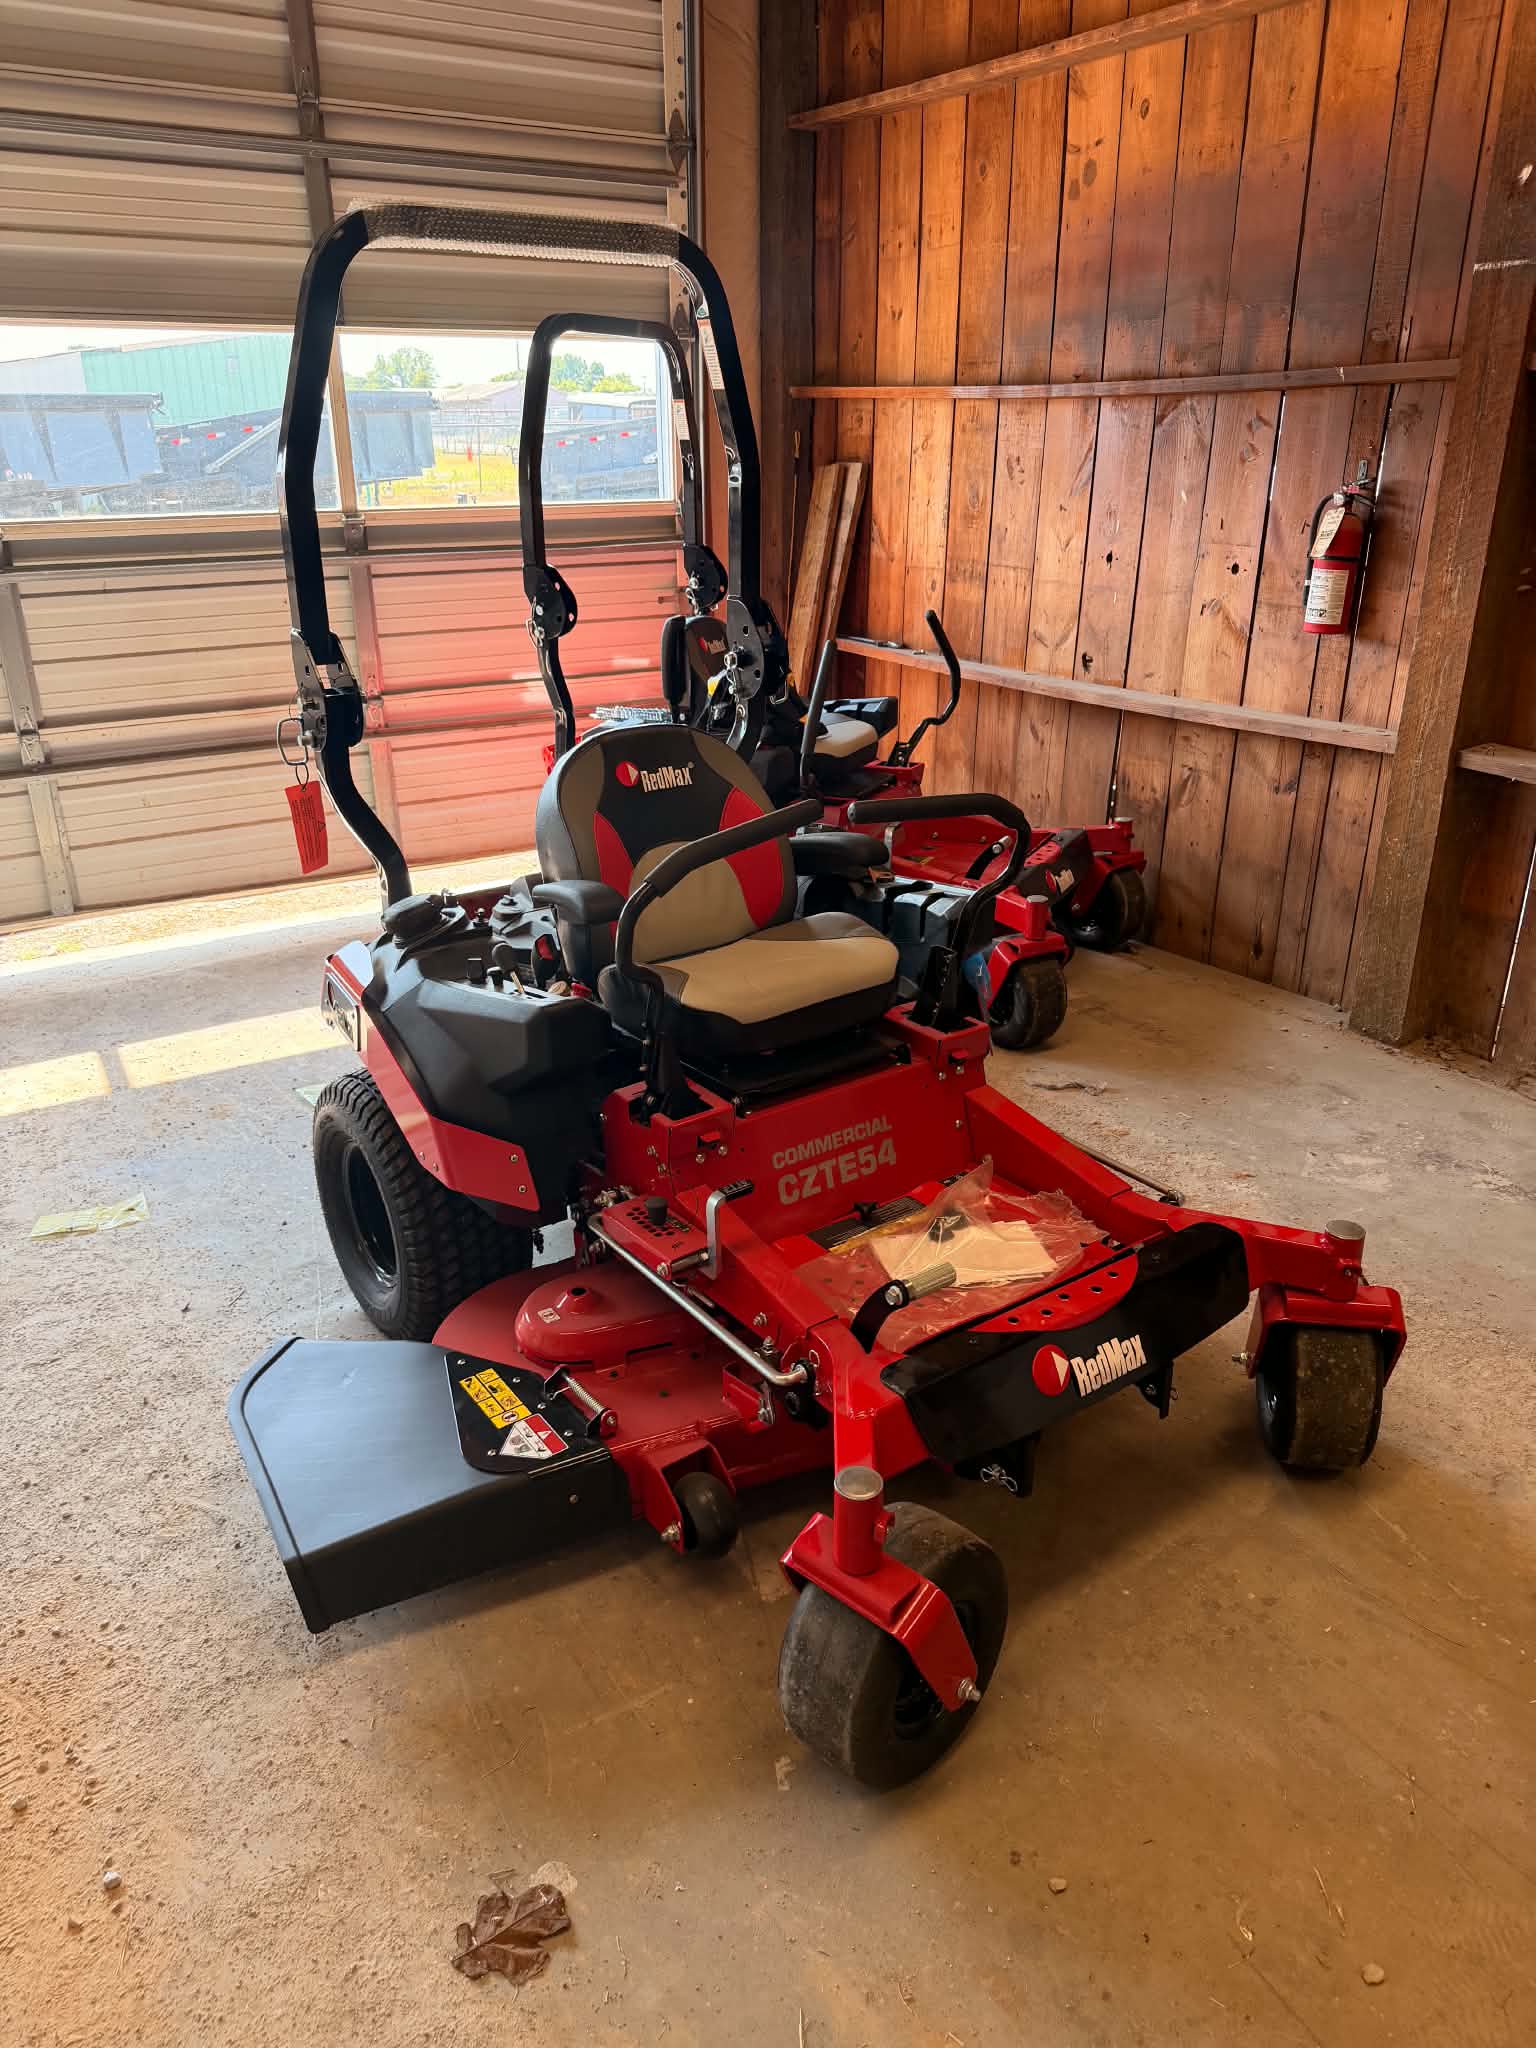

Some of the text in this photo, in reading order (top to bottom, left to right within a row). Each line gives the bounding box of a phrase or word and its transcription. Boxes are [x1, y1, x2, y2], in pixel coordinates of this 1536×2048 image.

[640, 766, 692, 792] RedMax
[772, 1114, 893, 1169] COMMERCIAL
[778, 1138, 897, 1205] CZTE54
[1070, 1334, 1147, 1397] RedMax
